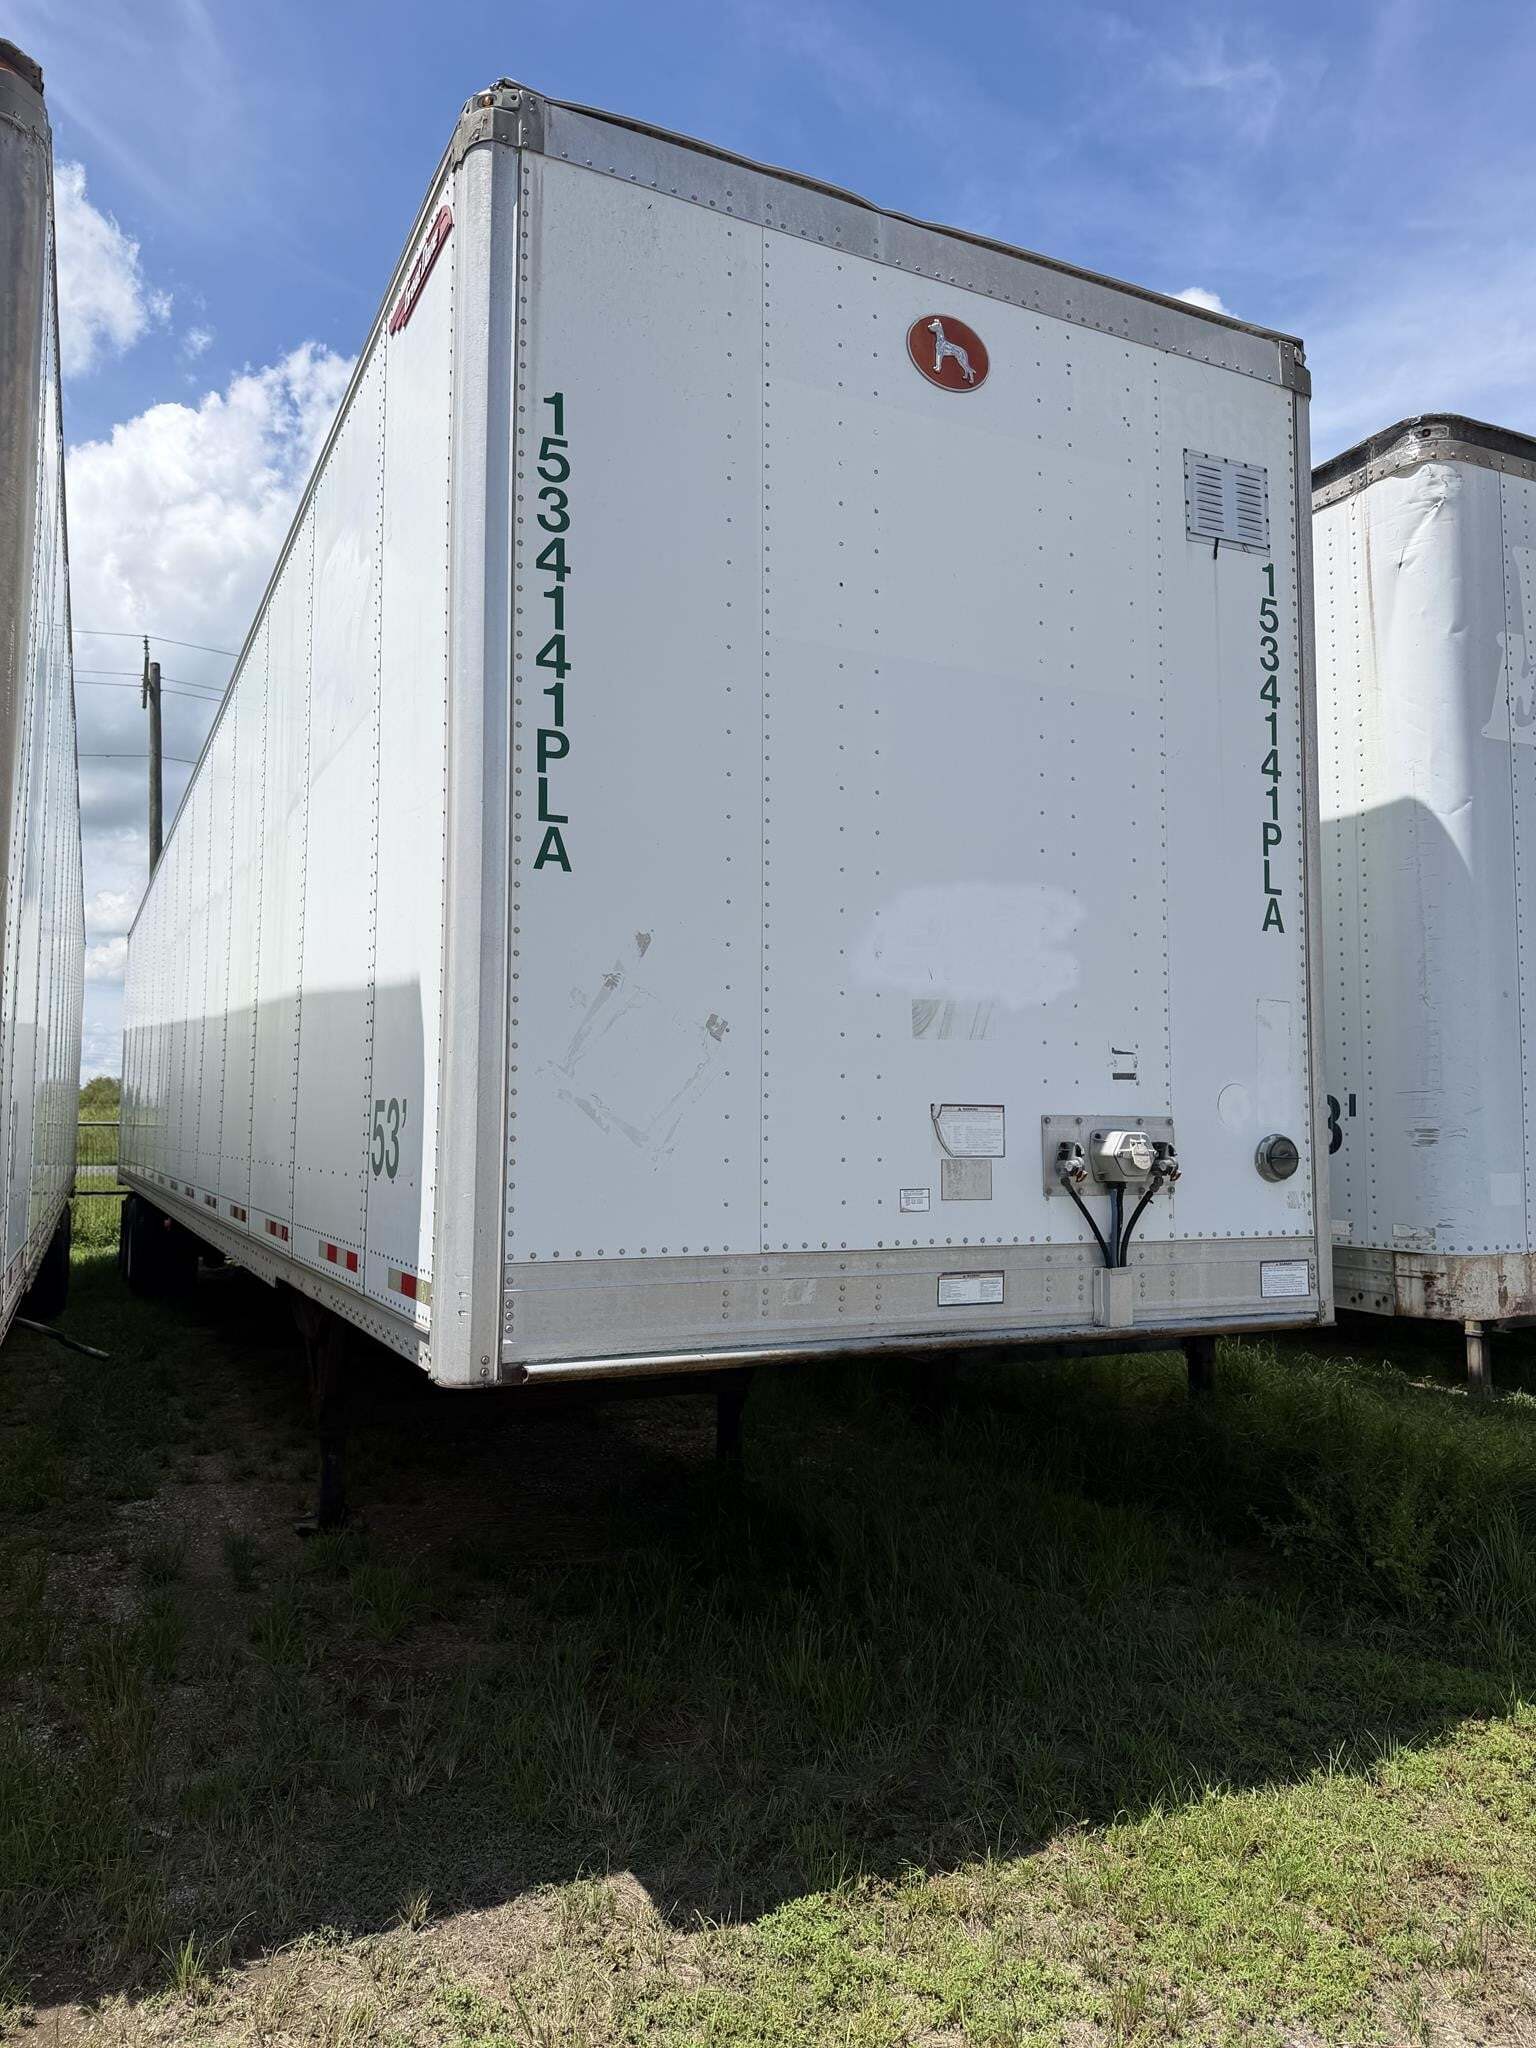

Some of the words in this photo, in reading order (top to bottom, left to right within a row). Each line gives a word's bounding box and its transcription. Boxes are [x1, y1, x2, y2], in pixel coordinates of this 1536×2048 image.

[533, 392, 572, 873] 1534141PLA
[1259, 563, 1285, 933] 1534141PLA
[371, 1097, 407, 1179] 53'
